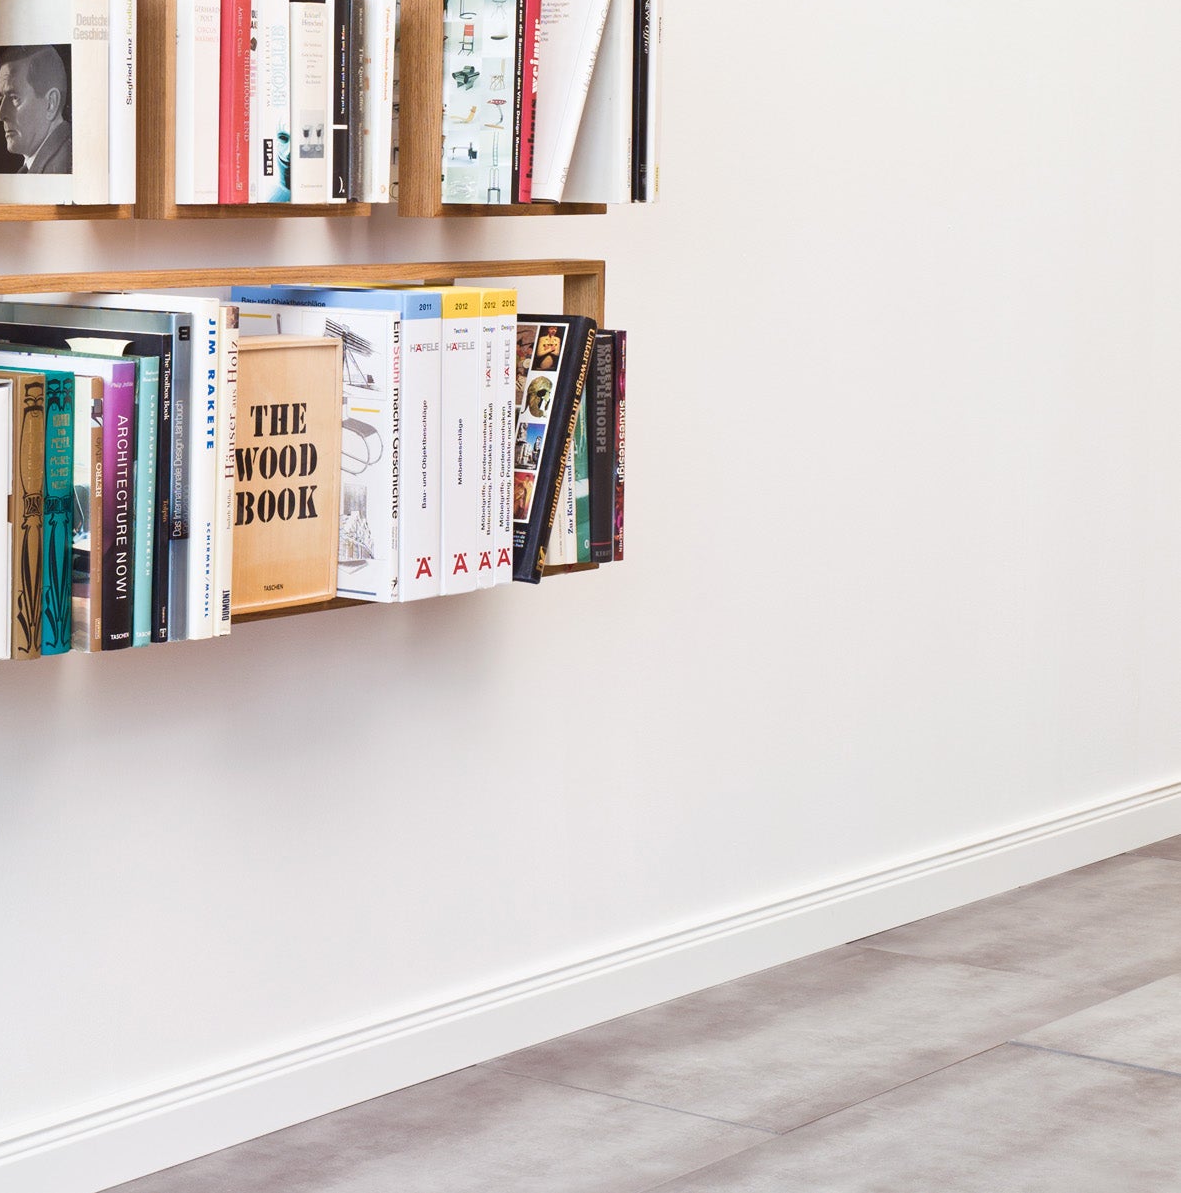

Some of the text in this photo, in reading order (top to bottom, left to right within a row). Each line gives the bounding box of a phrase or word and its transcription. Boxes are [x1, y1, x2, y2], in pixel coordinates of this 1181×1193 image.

[642, 24, 650, 54] Office
[126, 61, 134, 105] Siegfried
[418, 303, 432, 311] 2011
[455, 302, 468, 310] 2012
[501, 300, 515, 308] 2012
[410, 342, 439, 353] HÄFELE
[446, 341, 475, 351] HÄFELE
[503, 338, 511, 386] HÄFELE
[575, 328, 596, 396] Unterwegs
[206, 318, 216, 450] JIM RAKETE
[596, 343, 607, 453] MAPPLETHORPE
[250, 402, 308, 437] THE
[392, 388, 400, 434] macht
[172, 400, 184, 537] Das Internationale Design Jahrbuch
[221, 340, 239, 621] DUMONT Häuser Holz
[235, 443, 318, 481] WOOD
[391, 437, 400, 519] Geschichte
[115, 415, 129, 600] ARCHITECTURE NOW!
[234, 485, 318, 527] BOOK
[263, 583, 284, 591] TASCHEN
